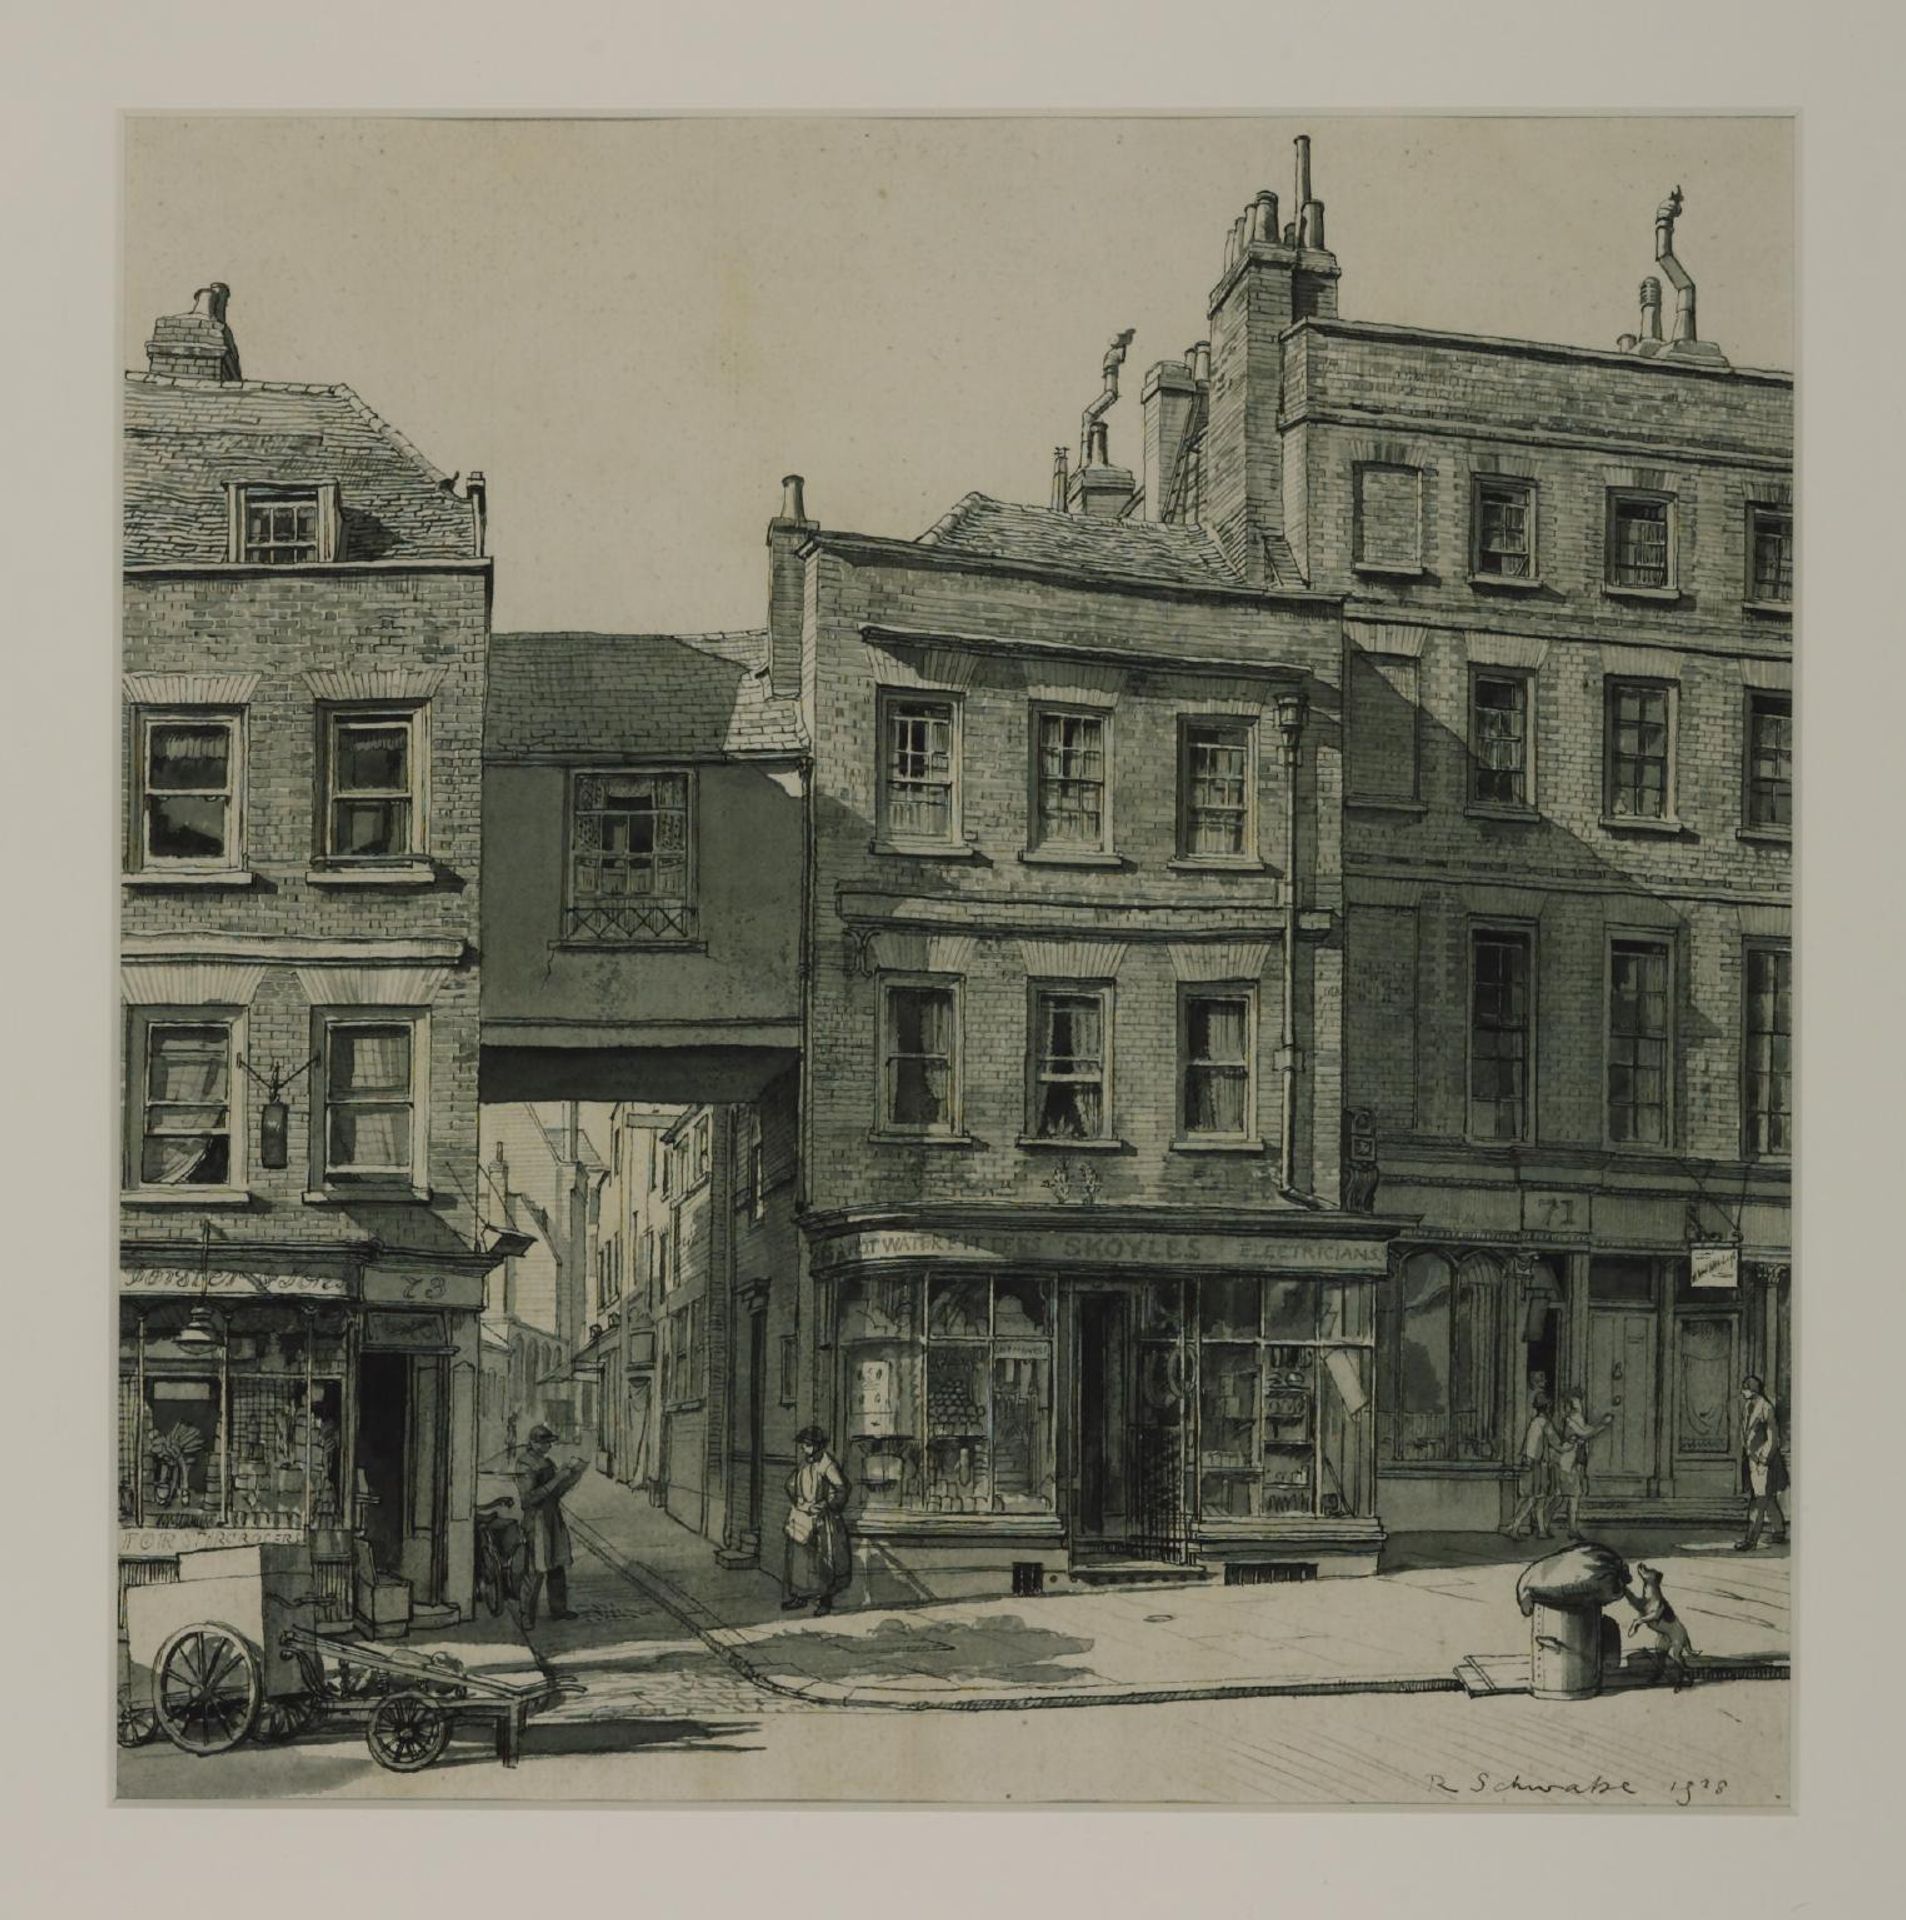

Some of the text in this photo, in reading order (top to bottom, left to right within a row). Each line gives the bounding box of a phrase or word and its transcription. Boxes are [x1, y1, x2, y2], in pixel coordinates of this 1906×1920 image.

[1537, 1197, 1576, 1226] 71
[882, 1231, 943, 1253] WATER
[1428, 1774, 1459, 1793] R
[1470, 1772, 1637, 1794] Schwabe
